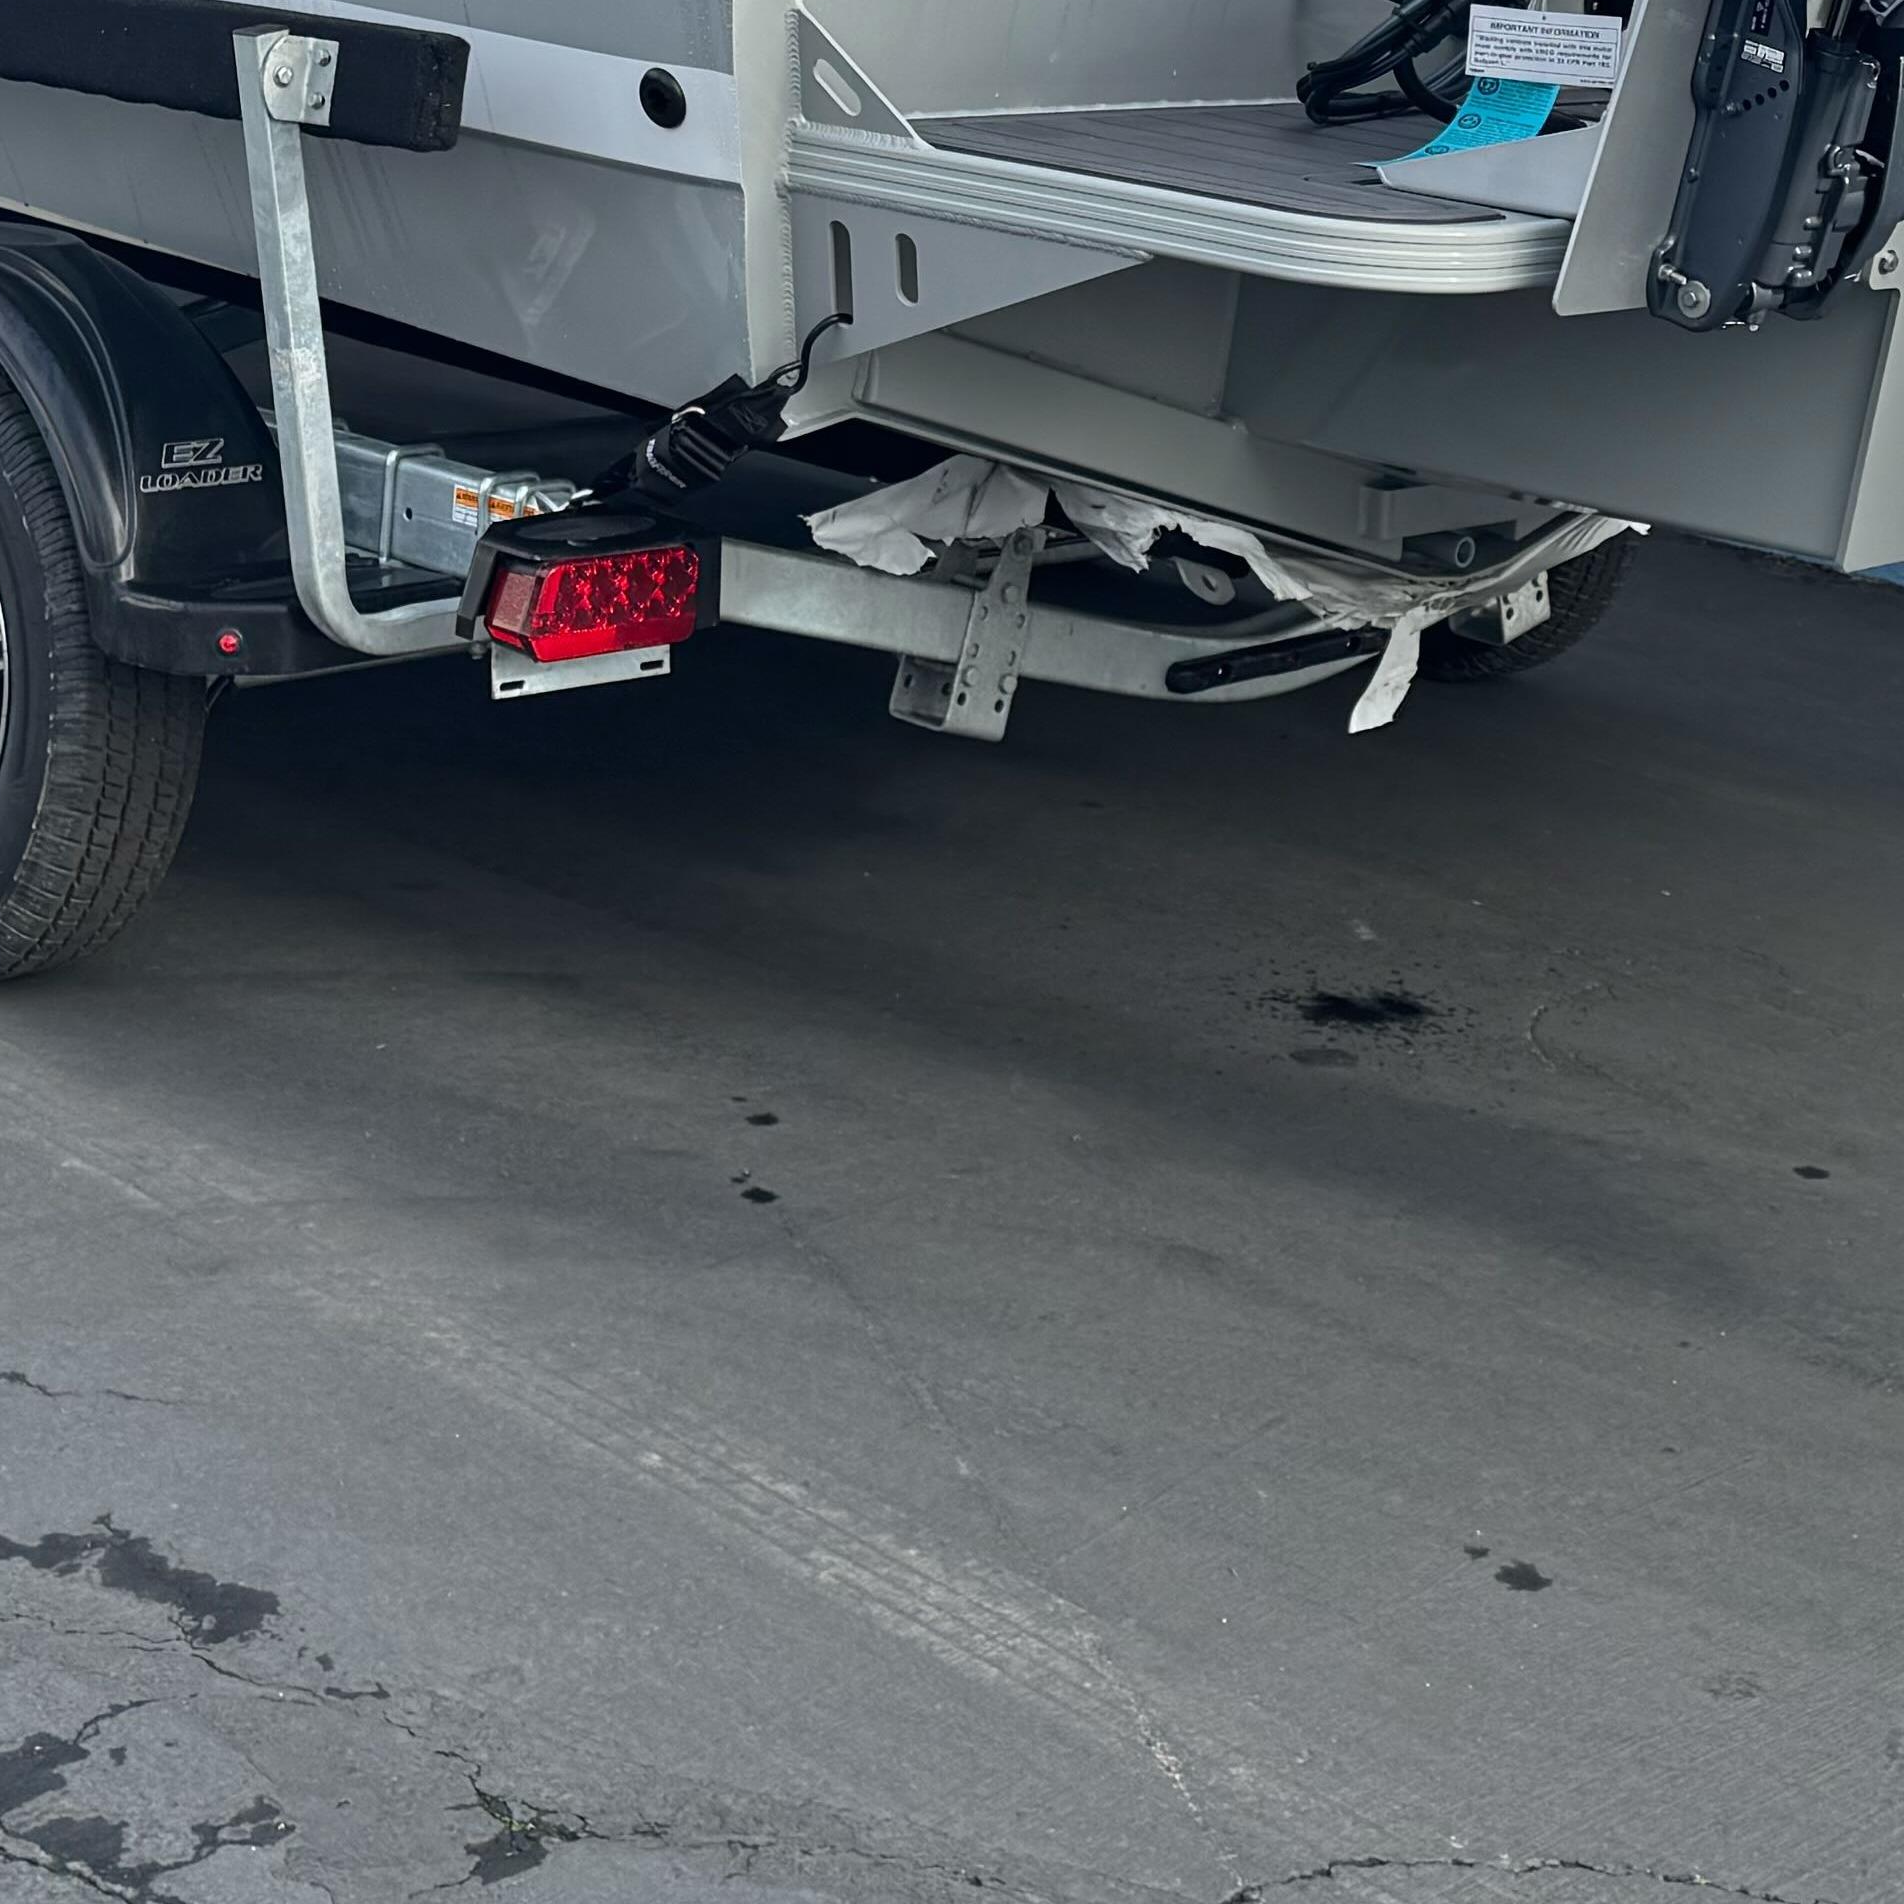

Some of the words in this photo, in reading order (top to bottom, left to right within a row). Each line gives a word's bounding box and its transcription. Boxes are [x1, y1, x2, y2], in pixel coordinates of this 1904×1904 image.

[1490, 21, 1539, 35] IMPORTANT
[1540, 27, 1601, 40] INFORMATION
[160, 437, 225, 469] EZ
[139, 463, 264, 494] LOADER
